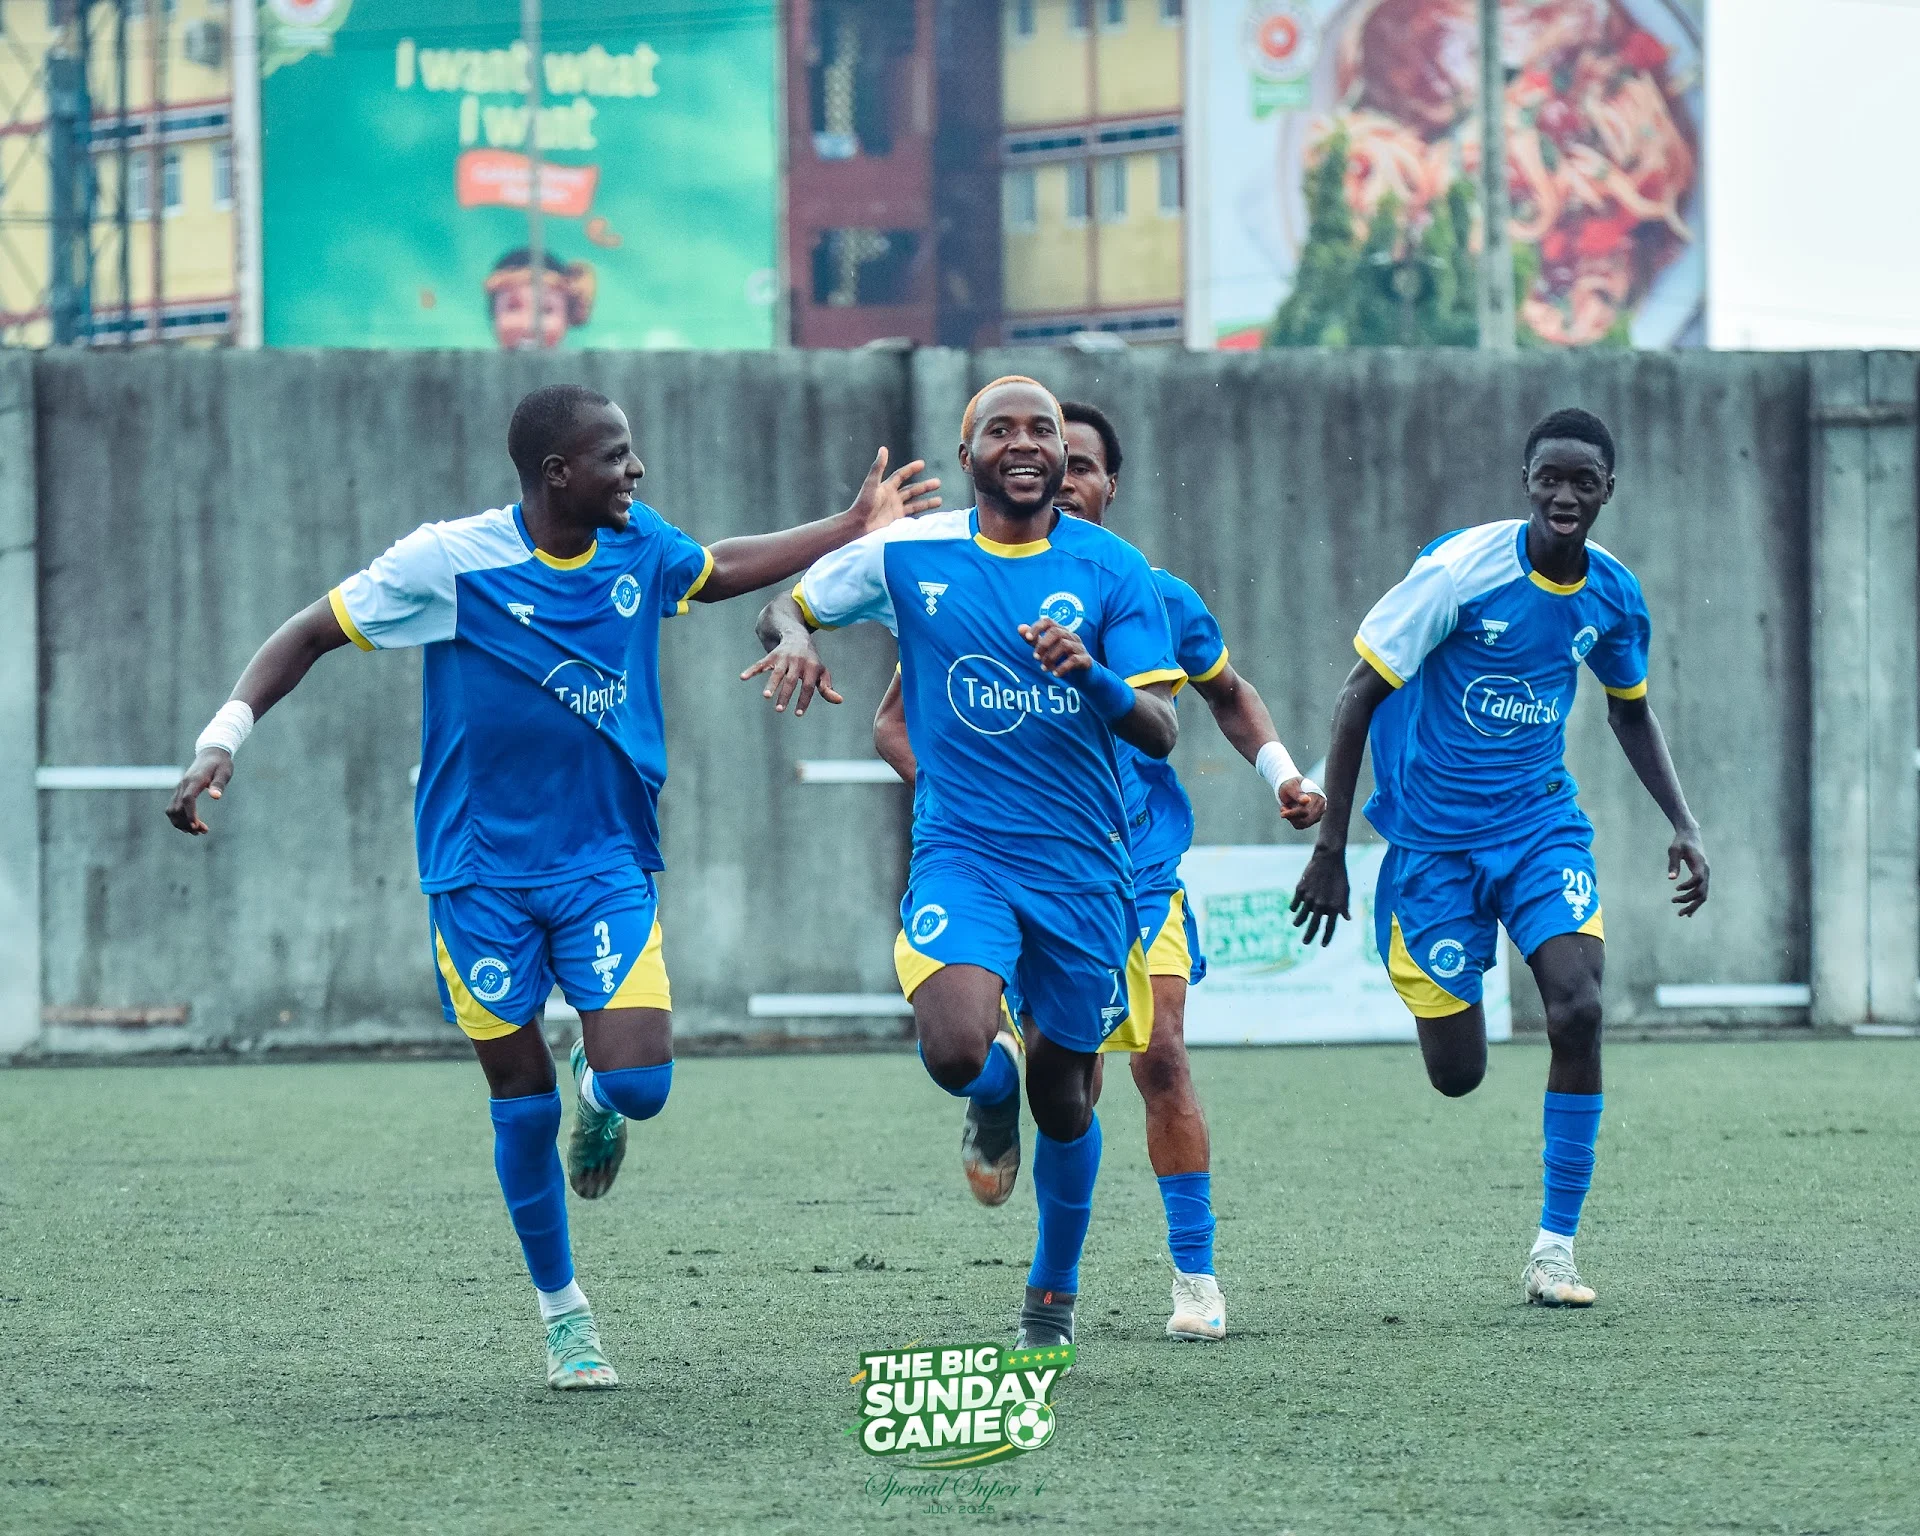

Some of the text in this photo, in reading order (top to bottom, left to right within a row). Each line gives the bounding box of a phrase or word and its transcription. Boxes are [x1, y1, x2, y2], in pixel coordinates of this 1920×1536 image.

[395, 39, 660, 98] I want what
[459, 94, 479, 146] I
[554, 678, 615, 715] Talent
[963, 677, 1081, 715] Talent 50
[1480, 687, 1543, 725] Talent
[1562, 868, 1592, 897] 20
[594, 920, 611, 958] 3
